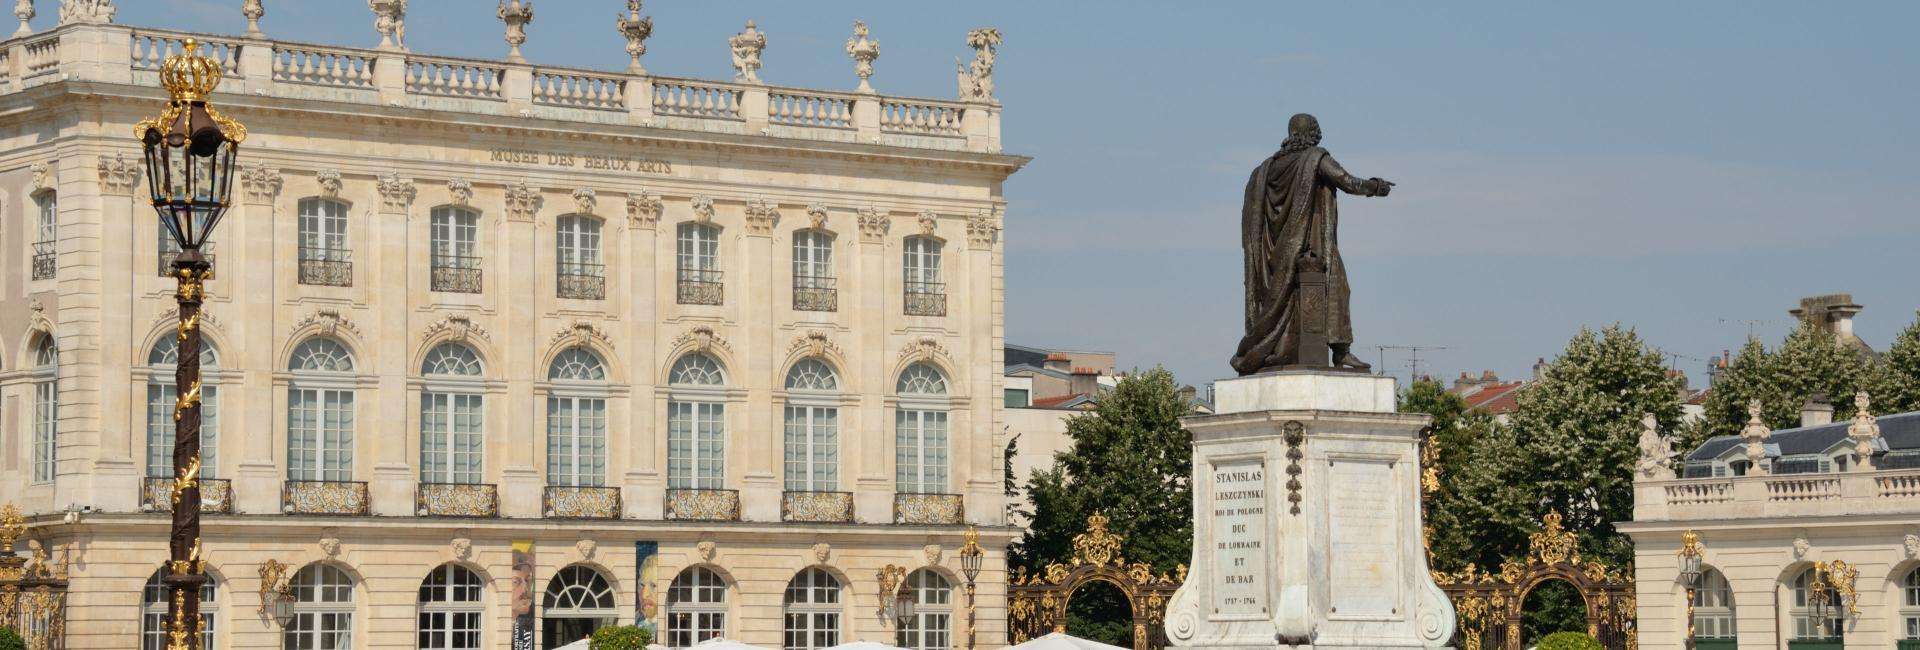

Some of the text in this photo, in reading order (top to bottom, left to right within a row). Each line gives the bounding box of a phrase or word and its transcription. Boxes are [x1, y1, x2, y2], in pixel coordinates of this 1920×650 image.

[547, 152, 575, 166] DES
[584, 155, 631, 171] BEAUX
[637, 159, 672, 174] ARTS
[1216, 471, 1262, 483] STANISLAS
[1237, 507, 1264, 516] POLOGNE
[1232, 524, 1246, 533] DUC
[1218, 541, 1261, 550] DE LORRAINE
[1234, 557, 1245, 567] ET
[1225, 574, 1254, 584] DE BAR
